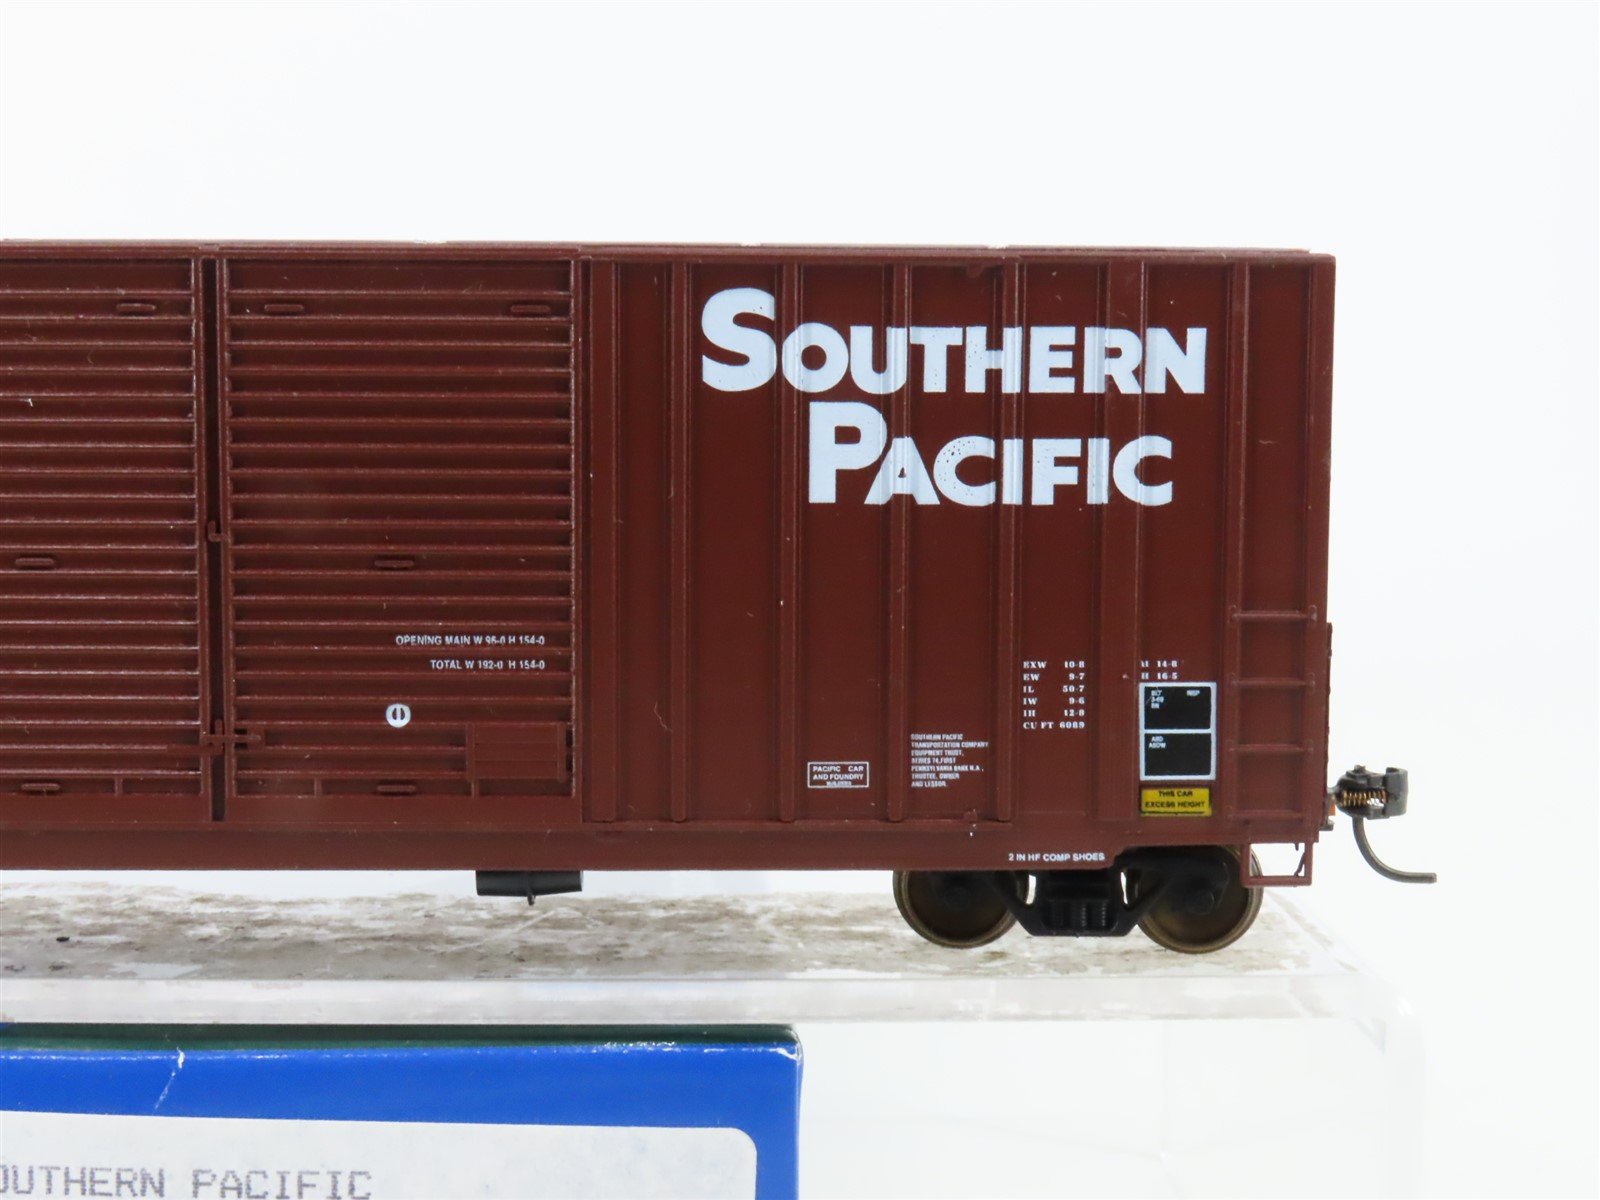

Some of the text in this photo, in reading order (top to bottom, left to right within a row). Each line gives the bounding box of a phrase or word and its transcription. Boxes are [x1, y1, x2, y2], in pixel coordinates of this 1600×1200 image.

[701, 287, 1207, 394] SOUTHERN
[808, 401, 1173, 507] PACIFIC
[396, 634, 442, 646] OPENING
[445, 634, 471, 645] MAIN
[473, 635, 483, 645] W
[508, 635, 516, 645] H
[519, 635, 545, 646] 154-0
[430, 659, 545, 669] TOTAL W 192-0 H 154-0
[1023, 660, 1047, 669] EXW
[1023, 672, 1085, 681] EW 9-7
[1023, 684, 1085, 694] IL 50-7
[1023, 697, 1038, 706] IW
[1023, 709, 1036, 717] IH
[1023, 721, 1037, 730] CU
[1041, 721, 1054, 730] FT
[942, 733, 963, 741] PACIFIC
[812, 765, 841, 773] PACIFIC
[813, 773, 864, 781] AND FOUNDRY
[1008, 852, 1106, 862] 2 IN HF COMP SHOES
[192, 1168, 372, 1200] PACIFIC
